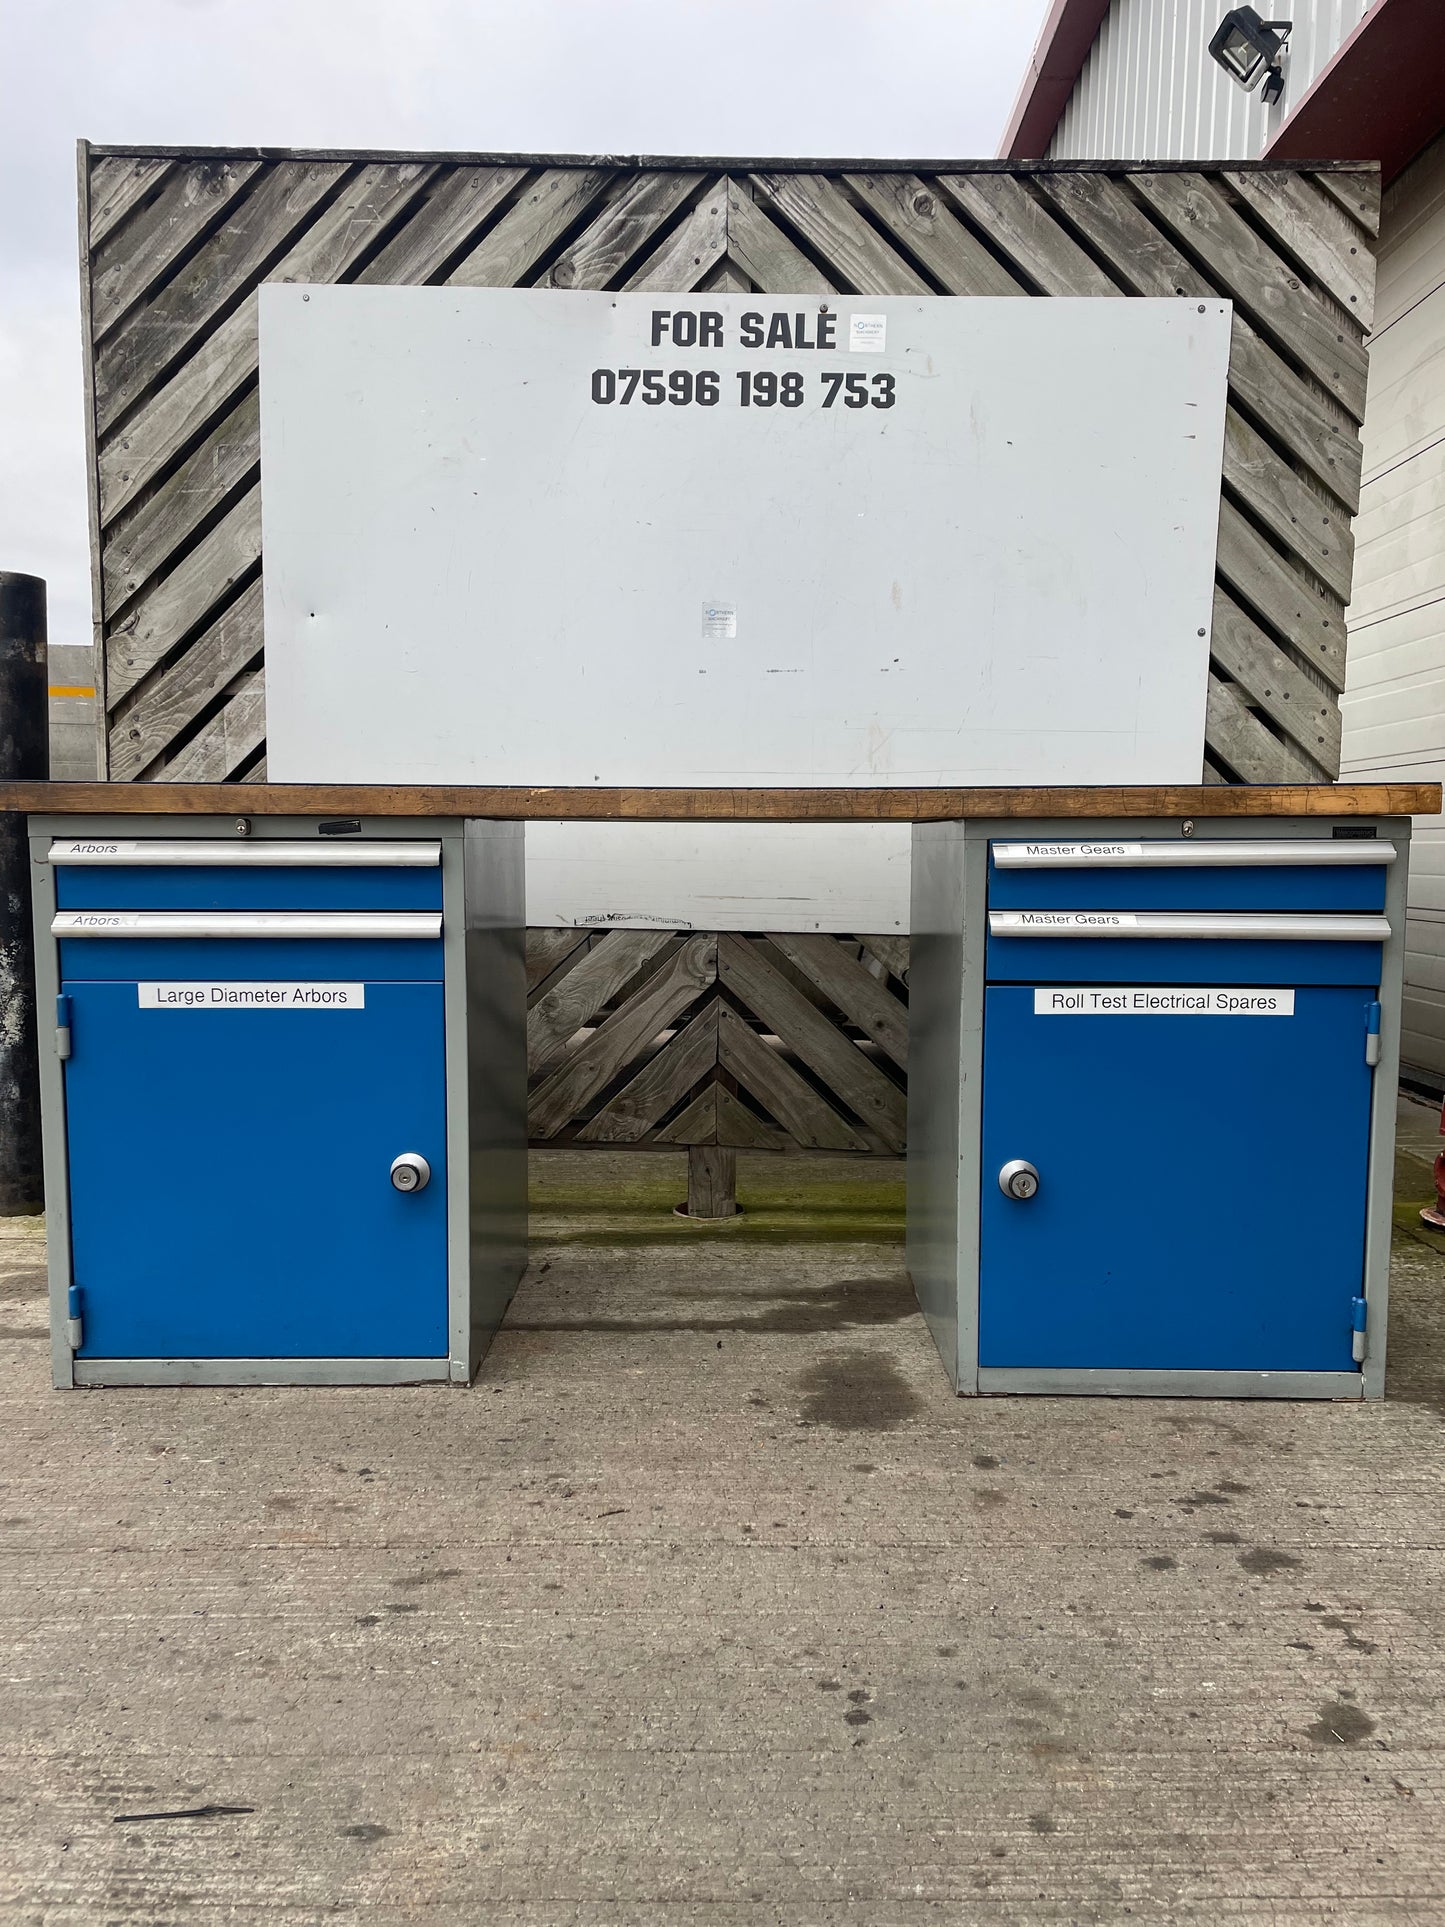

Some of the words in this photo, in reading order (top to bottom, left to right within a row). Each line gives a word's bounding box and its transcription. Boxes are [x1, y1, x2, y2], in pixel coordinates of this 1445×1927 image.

[651, 310, 724, 347] FOR
[740, 312, 837, 349] SALE
[591, 368, 720, 406] 07596
[736, 371, 804, 407] 198
[821, 373, 896, 409] 753
[70, 843, 118, 853] Arbors
[1026, 843, 1077, 855] Master
[1082, 843, 1125, 855] Gears
[72, 915, 120, 926] Arbors
[1021, 913, 1071, 925] Master
[1076, 913, 1120, 925] Gears
[157, 987, 205, 1006] Large
[211, 987, 287, 1003] Diameter
[292, 988, 347, 1003] Arbors
[1052, 993, 1084, 1009] Roll
[1090, 993, 1128, 1009] Test
[1133, 993, 1210, 1009] Electrical
[1216, 993, 1277, 1012] Spares
